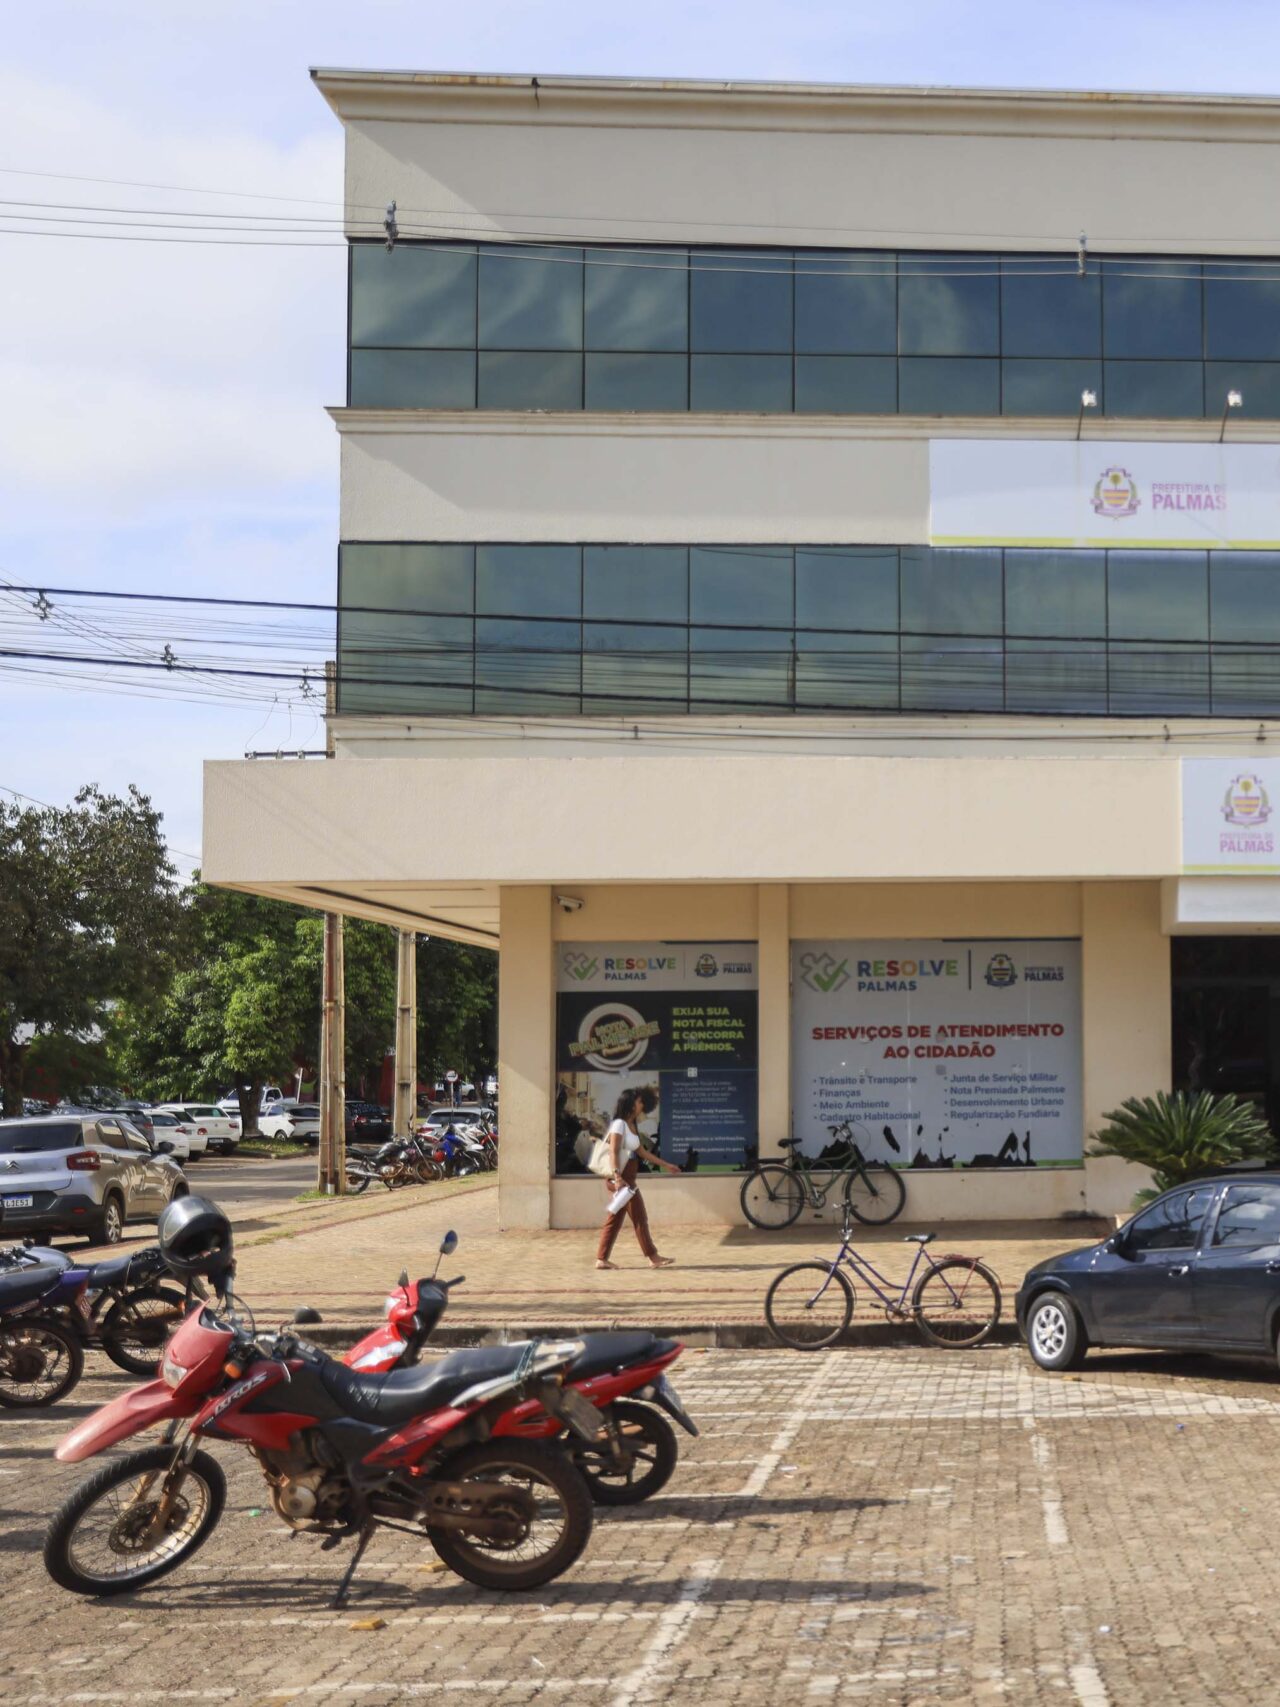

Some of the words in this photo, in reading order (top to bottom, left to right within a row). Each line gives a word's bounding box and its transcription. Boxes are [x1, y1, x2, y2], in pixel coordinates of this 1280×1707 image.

[1152, 483, 1209, 493] PREFEITURA
[1152, 494, 1227, 510] PALMAS
[1220, 840, 1274, 853] PALMAS
[604, 958, 676, 970] RESOLVE
[857, 960, 958, 977] RESOLVE
[604, 972, 647, 980] PALMAS
[1024, 972, 1064, 982] PALMAS
[858, 981, 917, 992] PALMAS
[672, 1007, 704, 1016] EXIJA
[707, 1007, 730, 1016] SUA
[672, 1019, 704, 1028] NOTA
[707, 1019, 745, 1028] FISCAL
[672, 1031, 680, 1040] E
[682, 1031, 744, 1040] CONCORRA
[812, 1026, 903, 1041] SERVIÇOS
[907, 1026, 931, 1038] DE
[937, 1024, 1064, 1038] ATENDIMENTO
[672, 1043, 681, 1051] A
[883, 1046, 909, 1059] AO
[914, 1041, 996, 1059] CIDADÃO
[819, 1076, 857, 1085] Trânsito
[950, 1074, 976, 1082] Junta
[978, 1074, 990, 1082] de
[992, 1073, 1027, 1083] Serviço
[1029, 1073, 1058, 1081] Militar
[819, 1089, 861, 1098] Finanças
[974, 1086, 1018, 1094] Premiada
[1021, 1085, 1065, 1093] Palmense
[819, 1101, 843, 1109] Meio
[845, 1100, 890, 1109] Ambiente
[950, 1098, 1029, 1107] Desenvolvimento
[1031, 1097, 1064, 1105] Urbano
[819, 1113, 862, 1121] Cadastro
[864, 1112, 921, 1121] Habitacional
[950, 1110, 1015, 1120] Regularização
[1018, 1109, 1060, 1118] Fundiária
